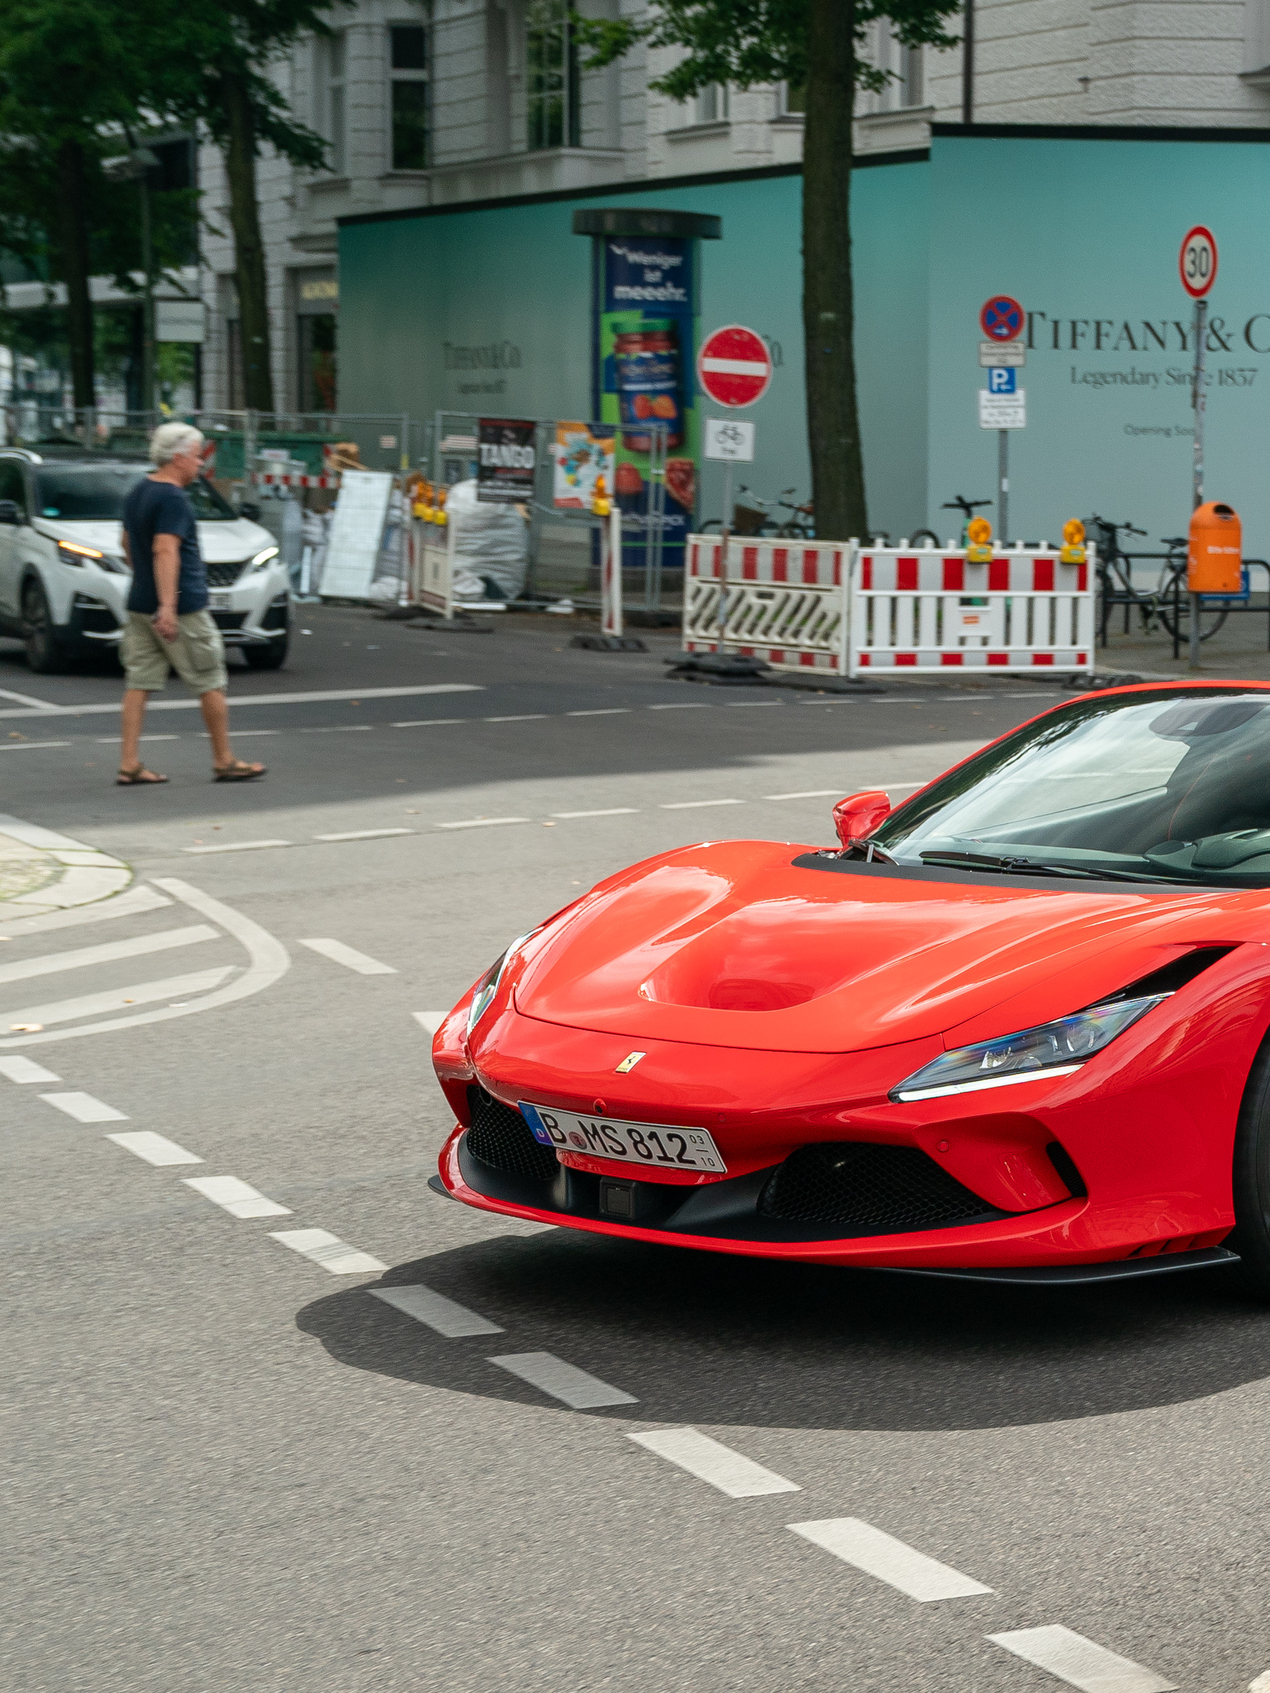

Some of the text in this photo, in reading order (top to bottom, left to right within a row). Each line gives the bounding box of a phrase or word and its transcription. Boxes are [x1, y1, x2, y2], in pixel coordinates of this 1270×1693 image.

[620, 248, 684, 270] Weniger
[1187, 246, 1209, 278] 30
[643, 267, 663, 283] ist
[1026, 311, 1193, 352] TIFFANY
[1205, 316, 1234, 352] &
[1070, 366, 1161, 390] Legendary
[1164, 367, 1214, 387] Sine
[1123, 423, 1172, 438] Opening
[478, 443, 536, 469] TANGO
[539, 1112, 697, 1165] B MS 812
[701, 1156, 716, 1167] 10
